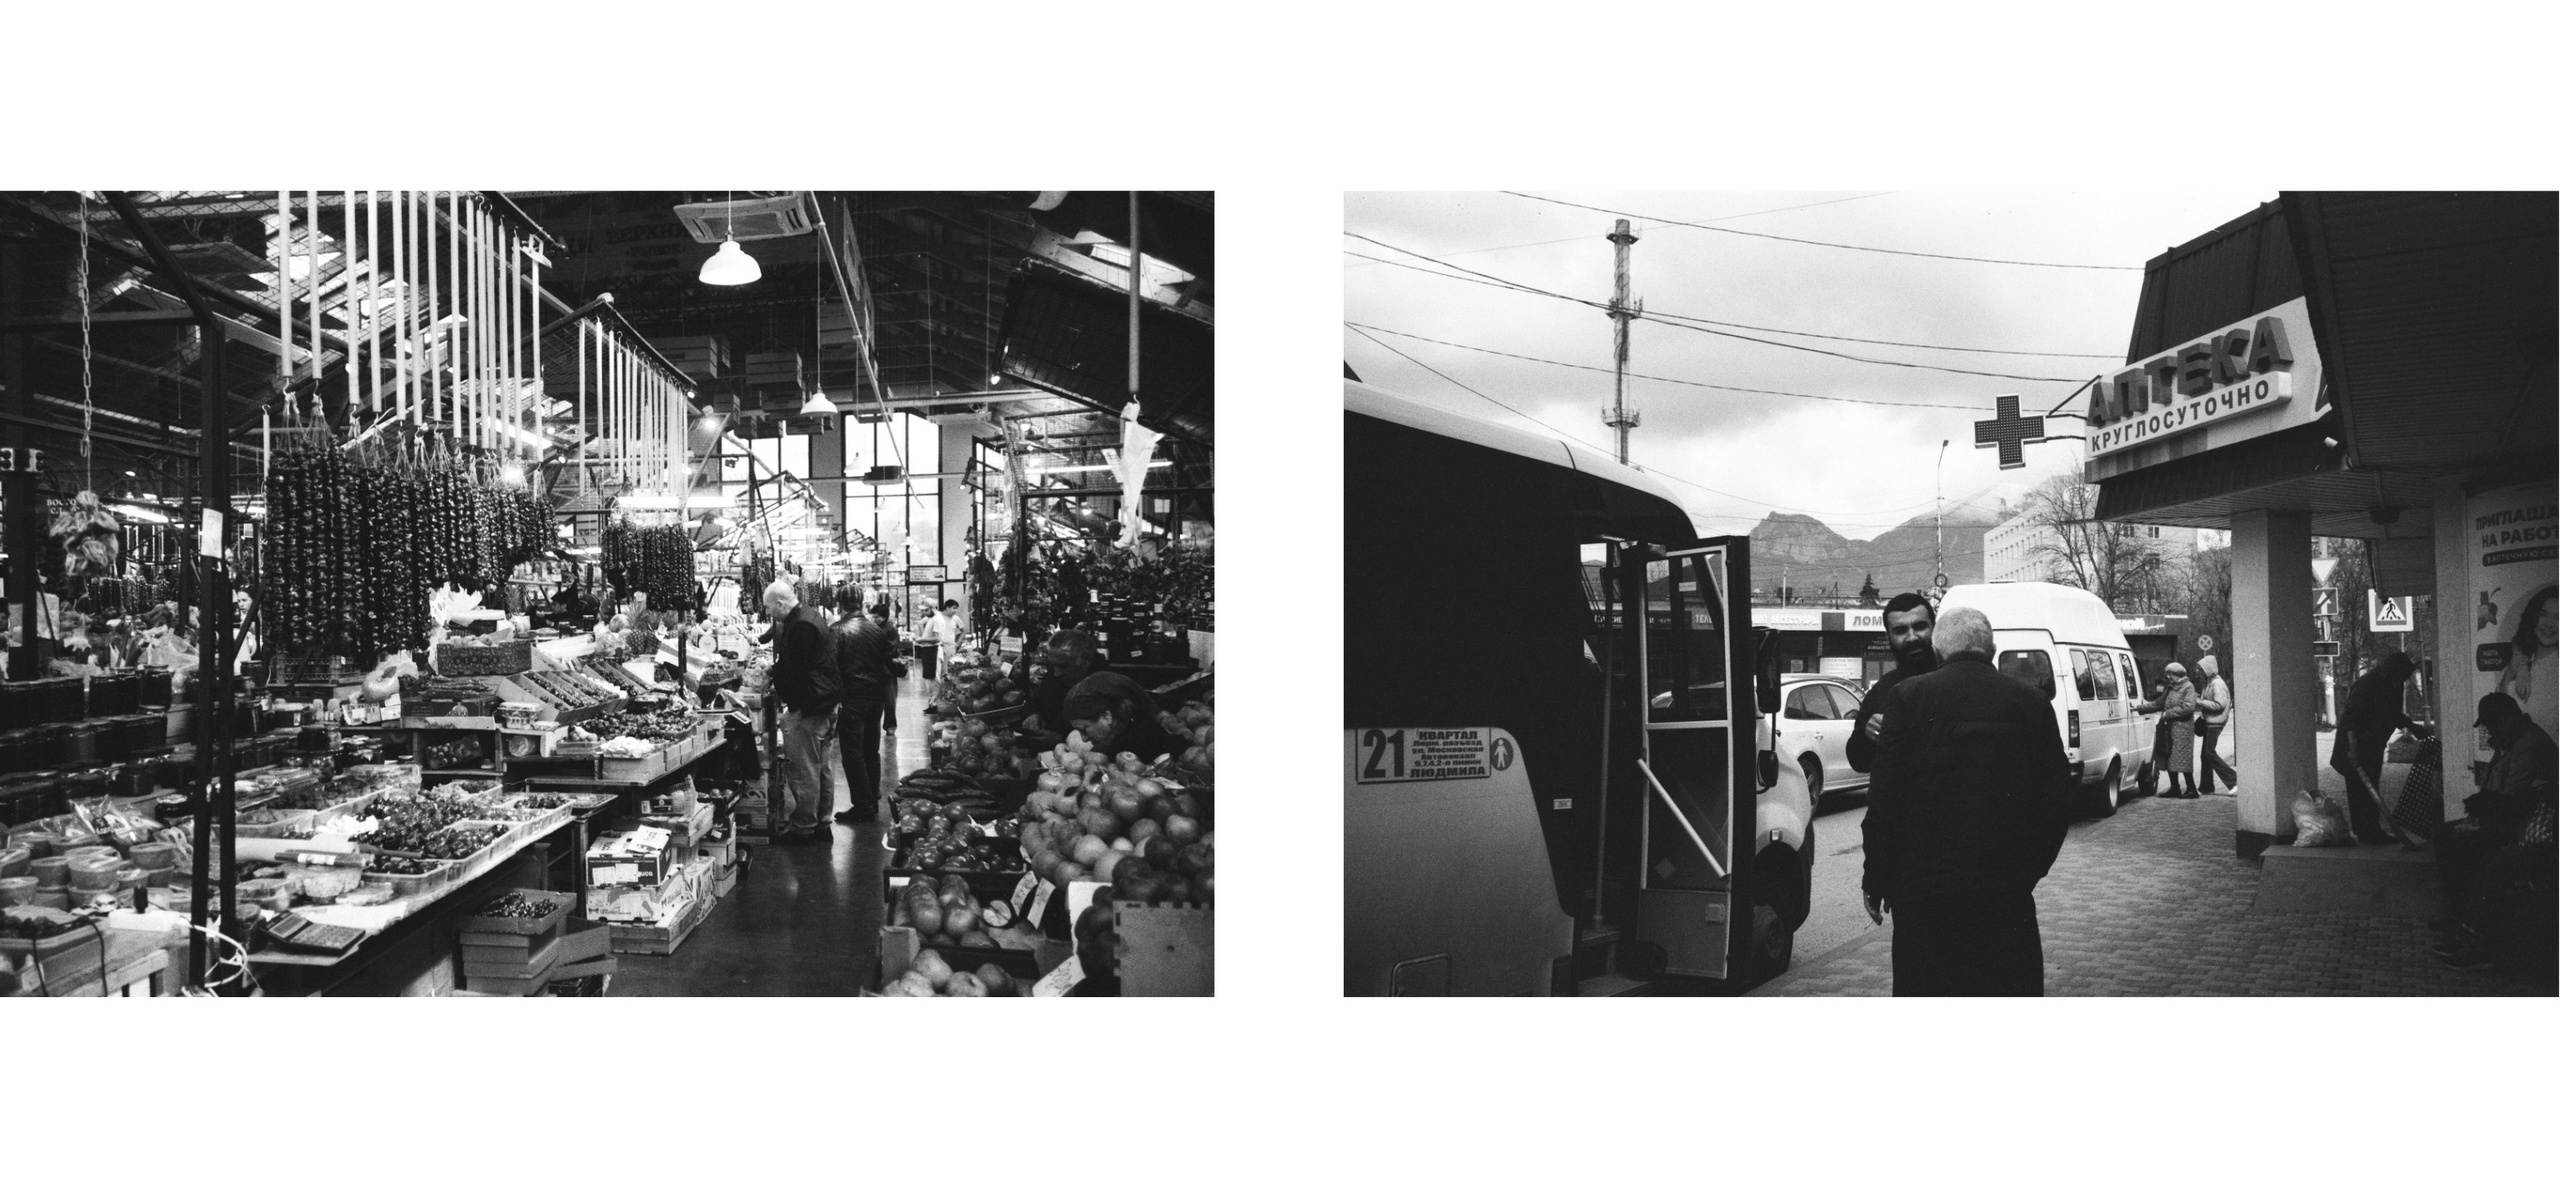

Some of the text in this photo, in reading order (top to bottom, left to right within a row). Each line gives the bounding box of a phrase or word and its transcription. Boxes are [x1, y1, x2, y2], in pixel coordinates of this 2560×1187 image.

[2087, 316, 2294, 427] АПТЕКА
[2092, 380, 2269, 452] КРУГЛОСУТОЧНО
[2482, 533, 2498, 548] НА
[2492, 549, 2539, 563] АПТЕЧНУЮ
[2542, 548, 2558, 557] СЕ
[1853, 616, 1882, 626] ЛОМ
[1418, 731, 1478, 740] КВАРТАЛ
[1364, 729, 1404, 779] 21
[1410, 766, 1486, 778] ЛЮДМИЛА
